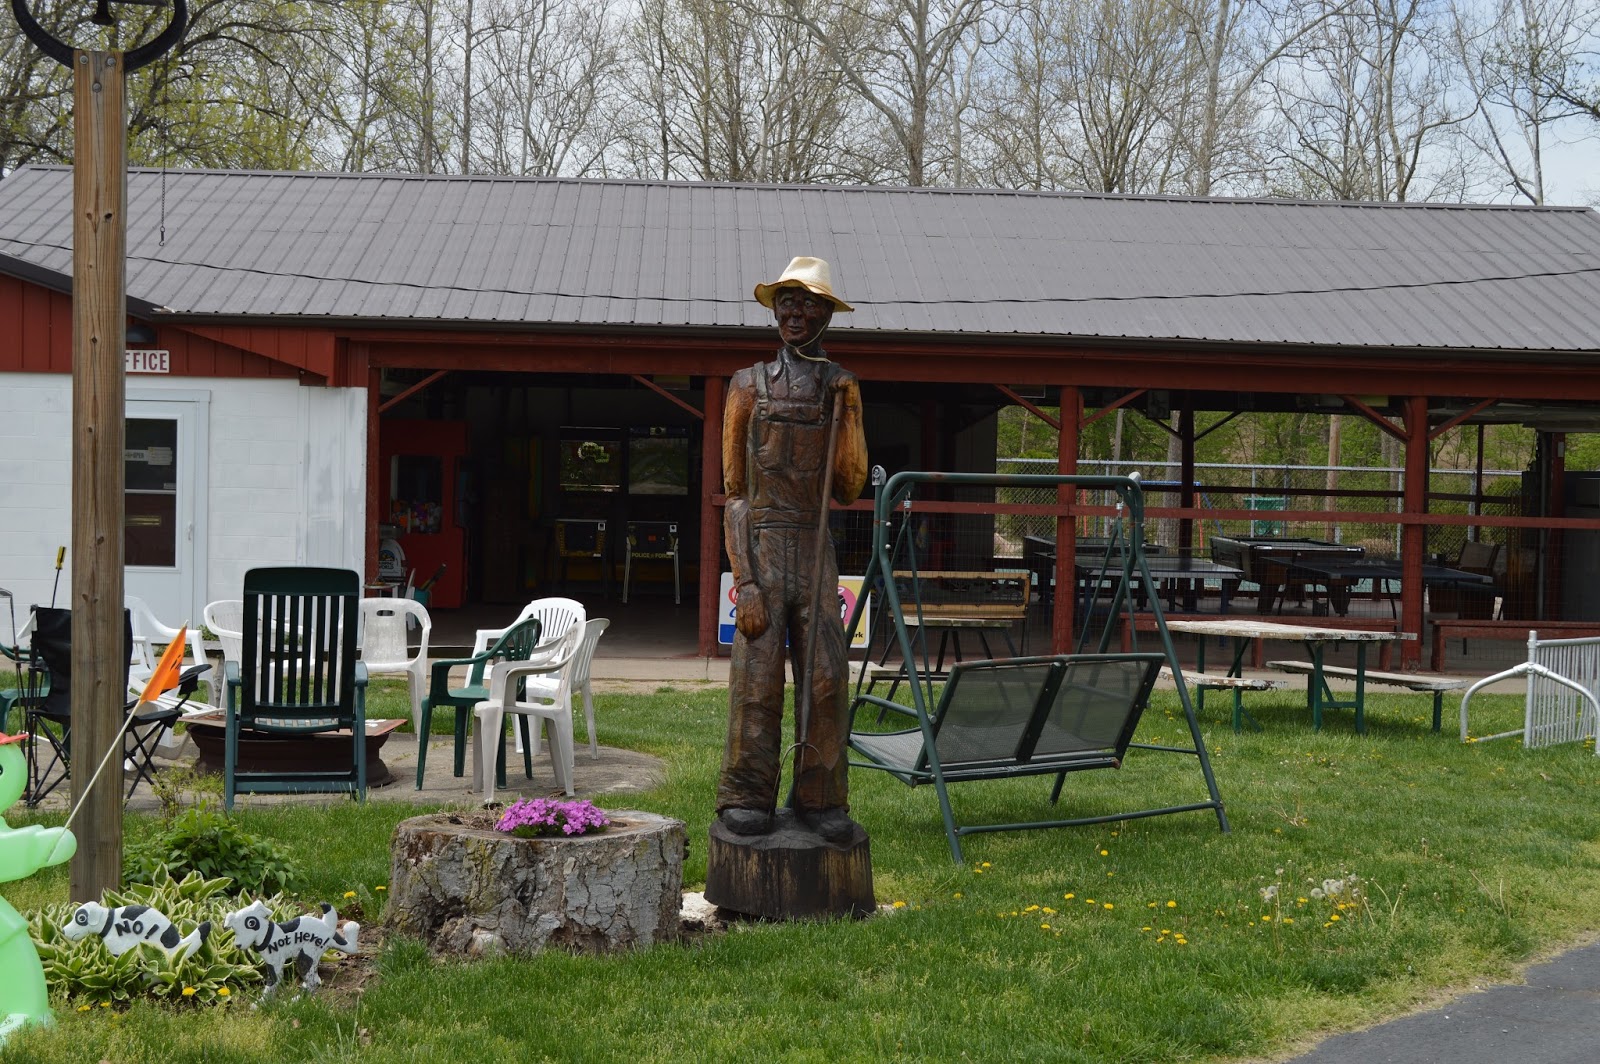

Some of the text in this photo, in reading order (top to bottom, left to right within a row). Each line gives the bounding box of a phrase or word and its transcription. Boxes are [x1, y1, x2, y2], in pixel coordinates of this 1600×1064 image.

[125, 352, 167, 370] FFICE
[114, 920, 160, 939] NO!
[267, 931, 330, 954] Not Here!
